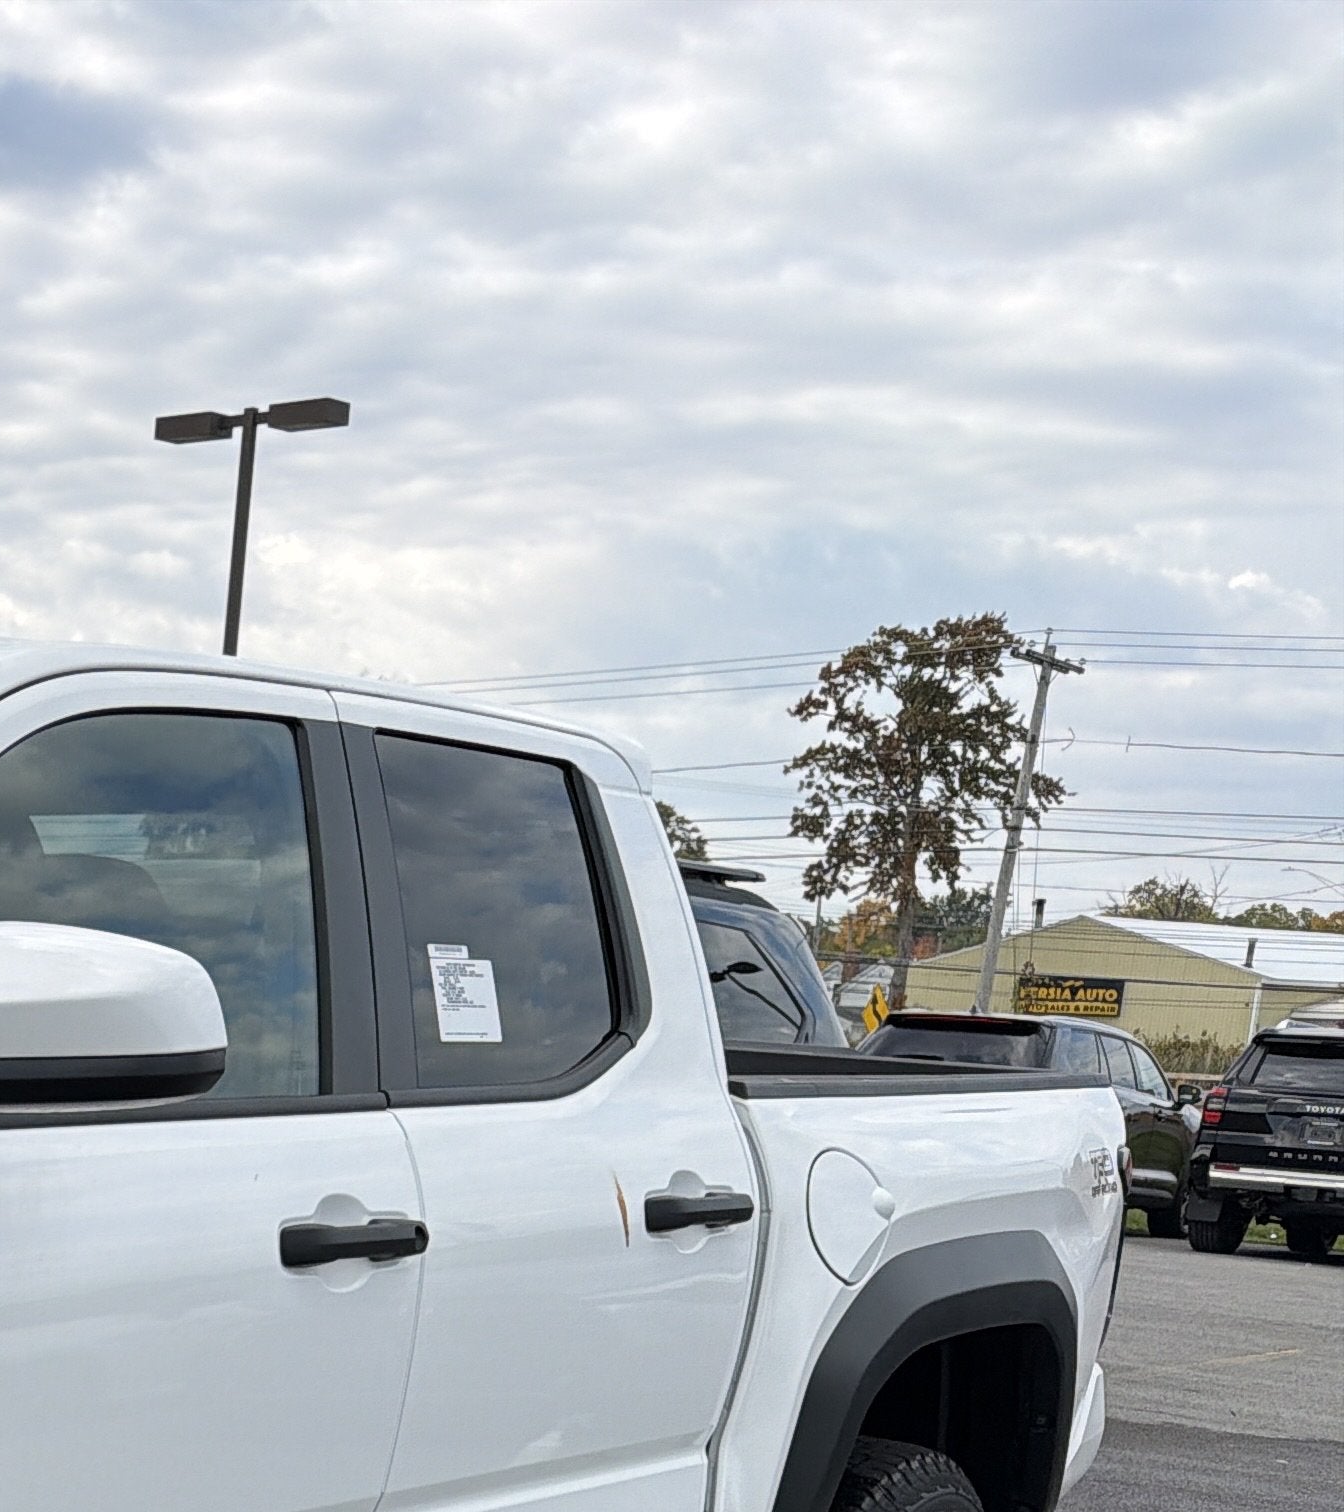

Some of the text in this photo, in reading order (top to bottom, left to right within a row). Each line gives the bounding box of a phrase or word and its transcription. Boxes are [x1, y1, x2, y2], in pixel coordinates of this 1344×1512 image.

[1075, 988, 1118, 1002] AUTO
[1045, 1003, 1070, 1013] SALES
[1073, 1003, 1081, 1013] &
[1083, 1004, 1116, 1014] REPAIR
